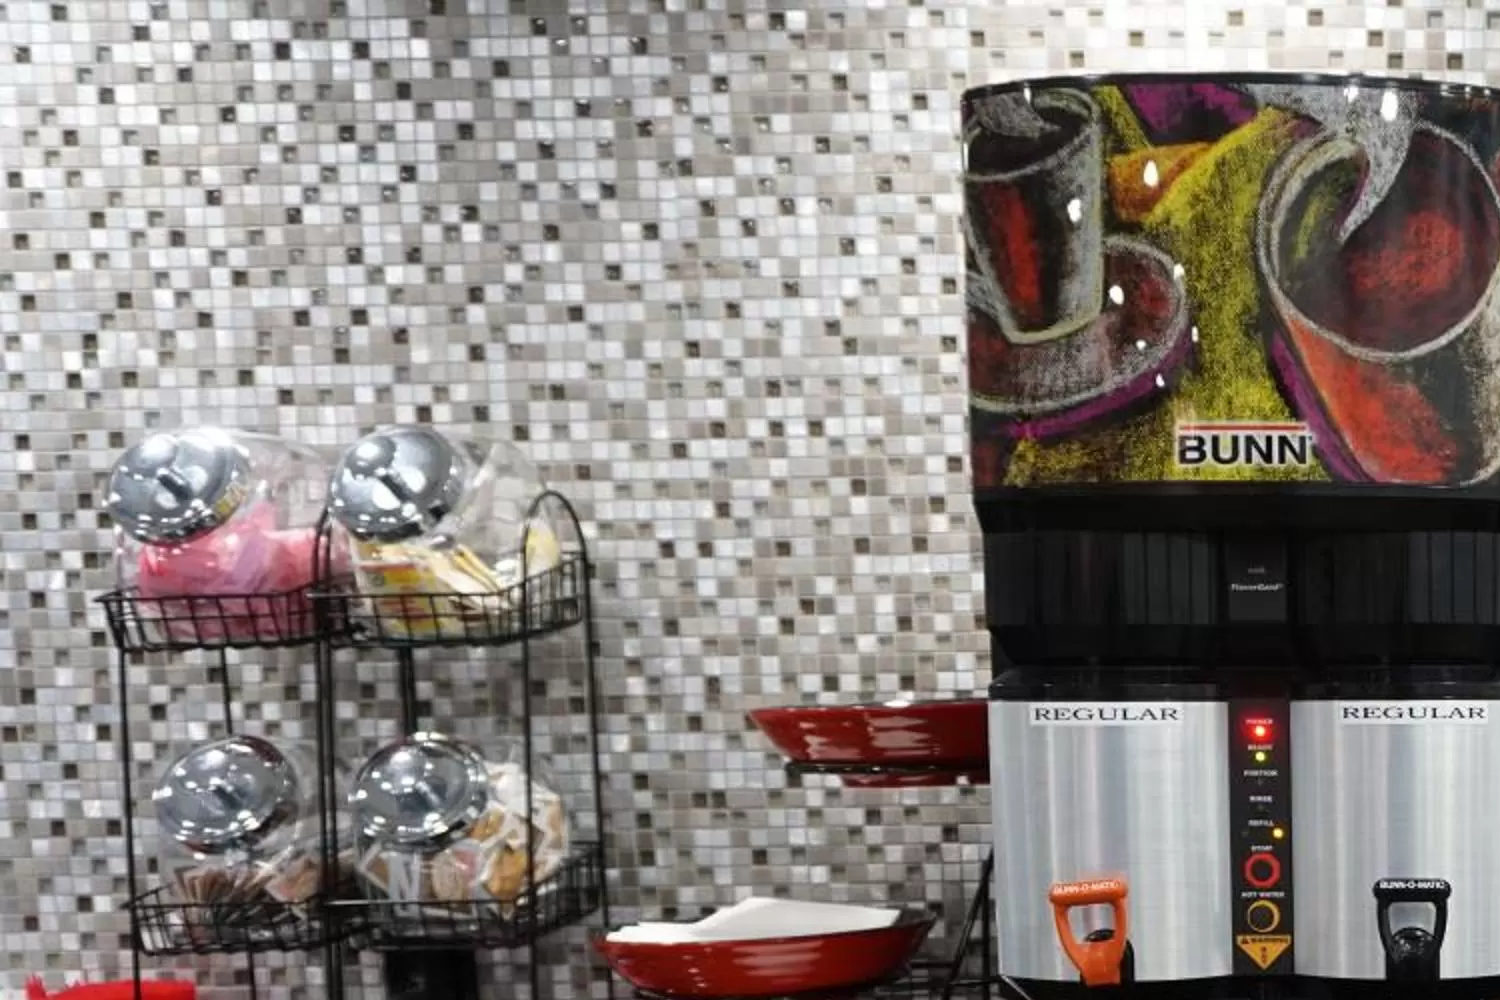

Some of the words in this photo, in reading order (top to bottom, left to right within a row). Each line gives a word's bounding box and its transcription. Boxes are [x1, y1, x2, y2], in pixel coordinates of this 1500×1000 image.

[1179, 434, 1308, 465] BUNN
[1034, 707, 1180, 722] REGULAR
[1342, 706, 1487, 720] REGULAR
